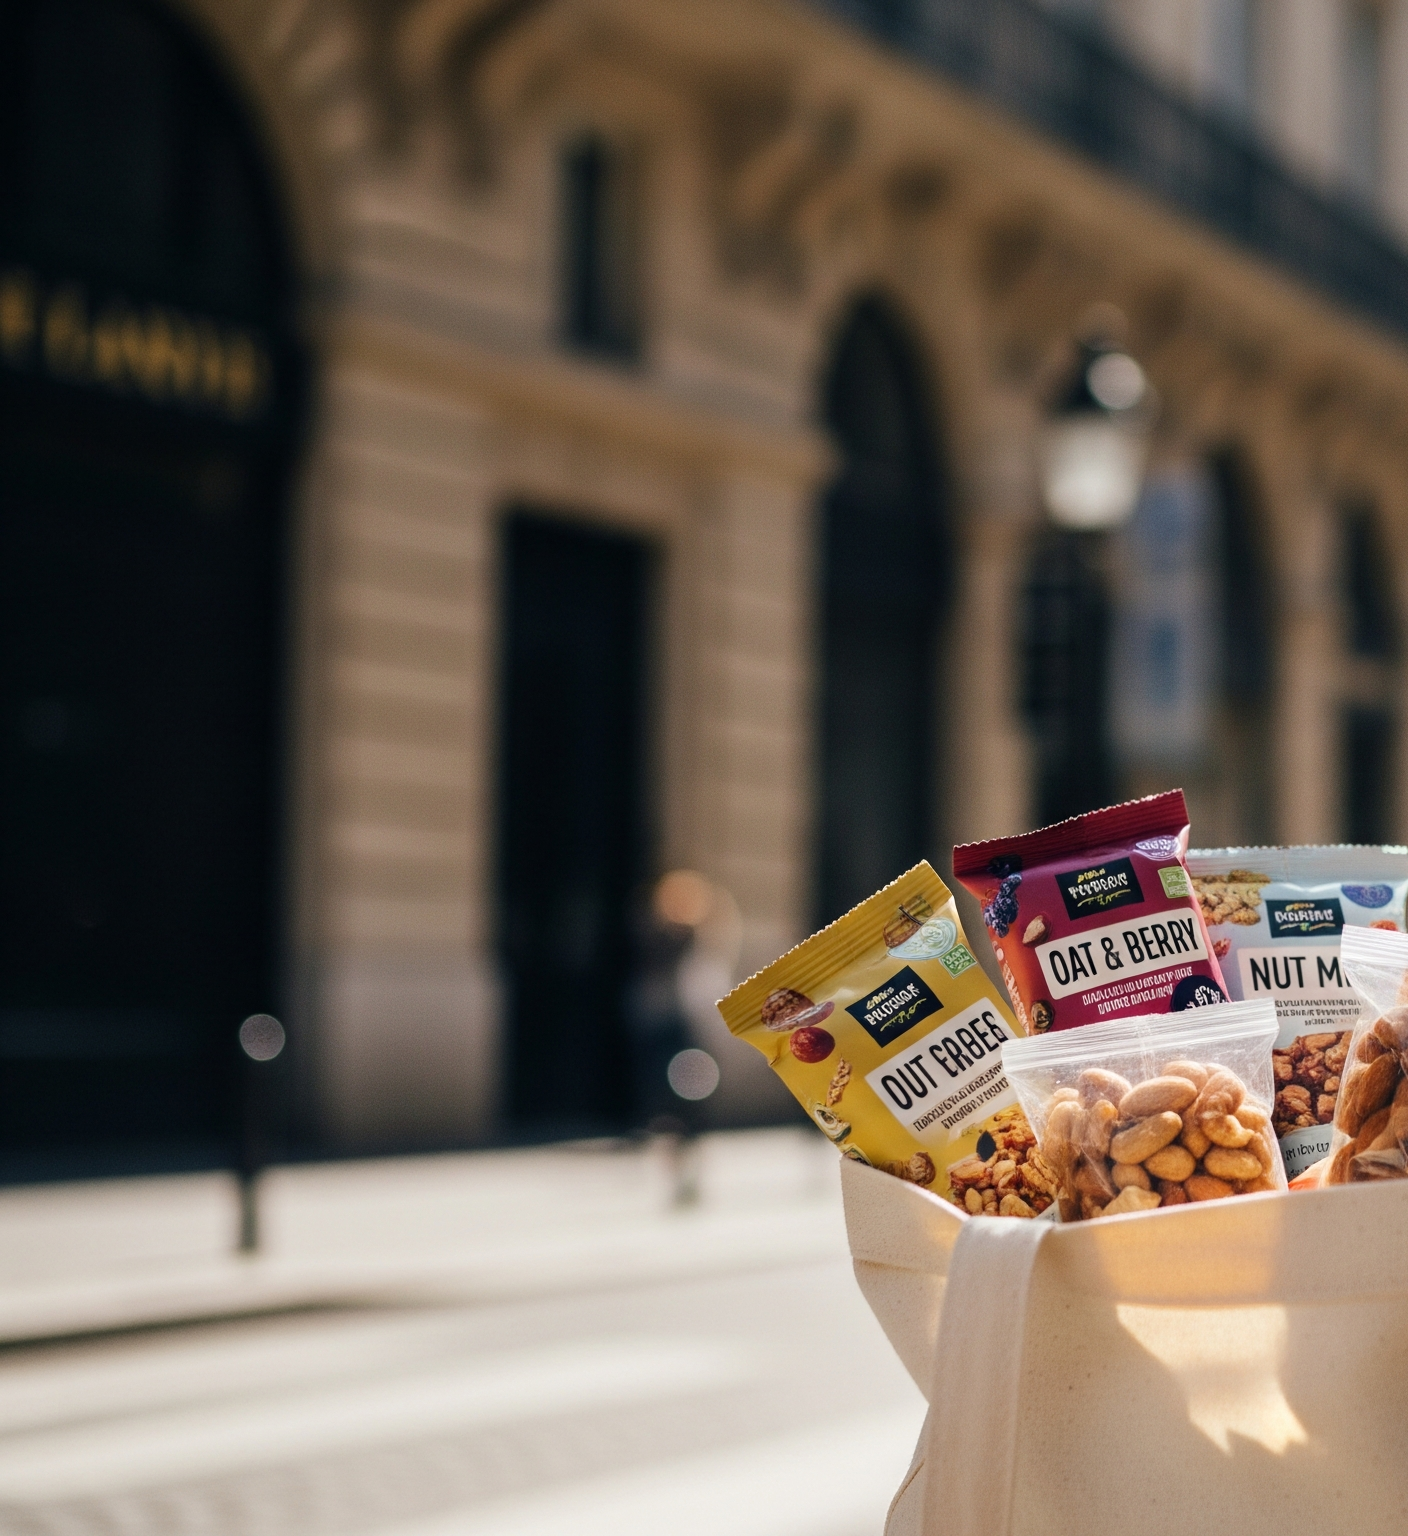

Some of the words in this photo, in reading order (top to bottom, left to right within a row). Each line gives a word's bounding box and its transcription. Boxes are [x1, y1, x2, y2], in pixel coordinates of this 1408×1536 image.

[1048, 941, 1098, 986] OAT
[1100, 937, 1124, 971] &
[1122, 917, 1199, 964] BERRY
[1249, 956, 1306, 991] NUT
[1316, 955, 1353, 988] M
[880, 1054, 939, 1110] OUT
